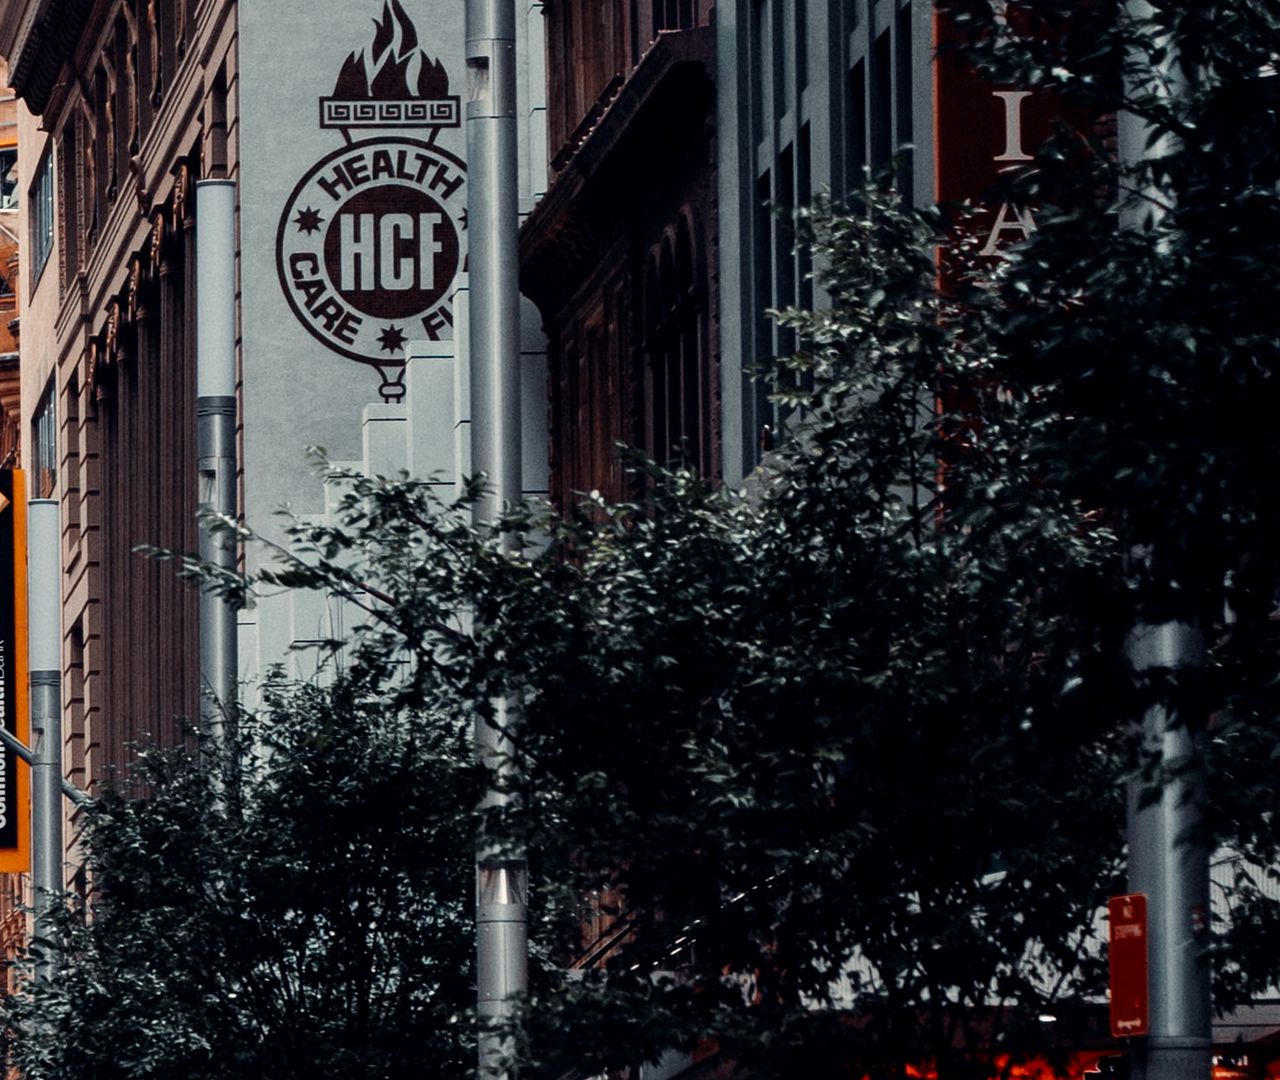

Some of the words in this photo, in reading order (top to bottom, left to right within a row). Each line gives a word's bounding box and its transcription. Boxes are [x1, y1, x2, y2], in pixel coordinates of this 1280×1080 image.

[316, 149, 465, 201] HEALTH
[340, 212, 443, 291] HCF
[290, 252, 363, 345] CARE
